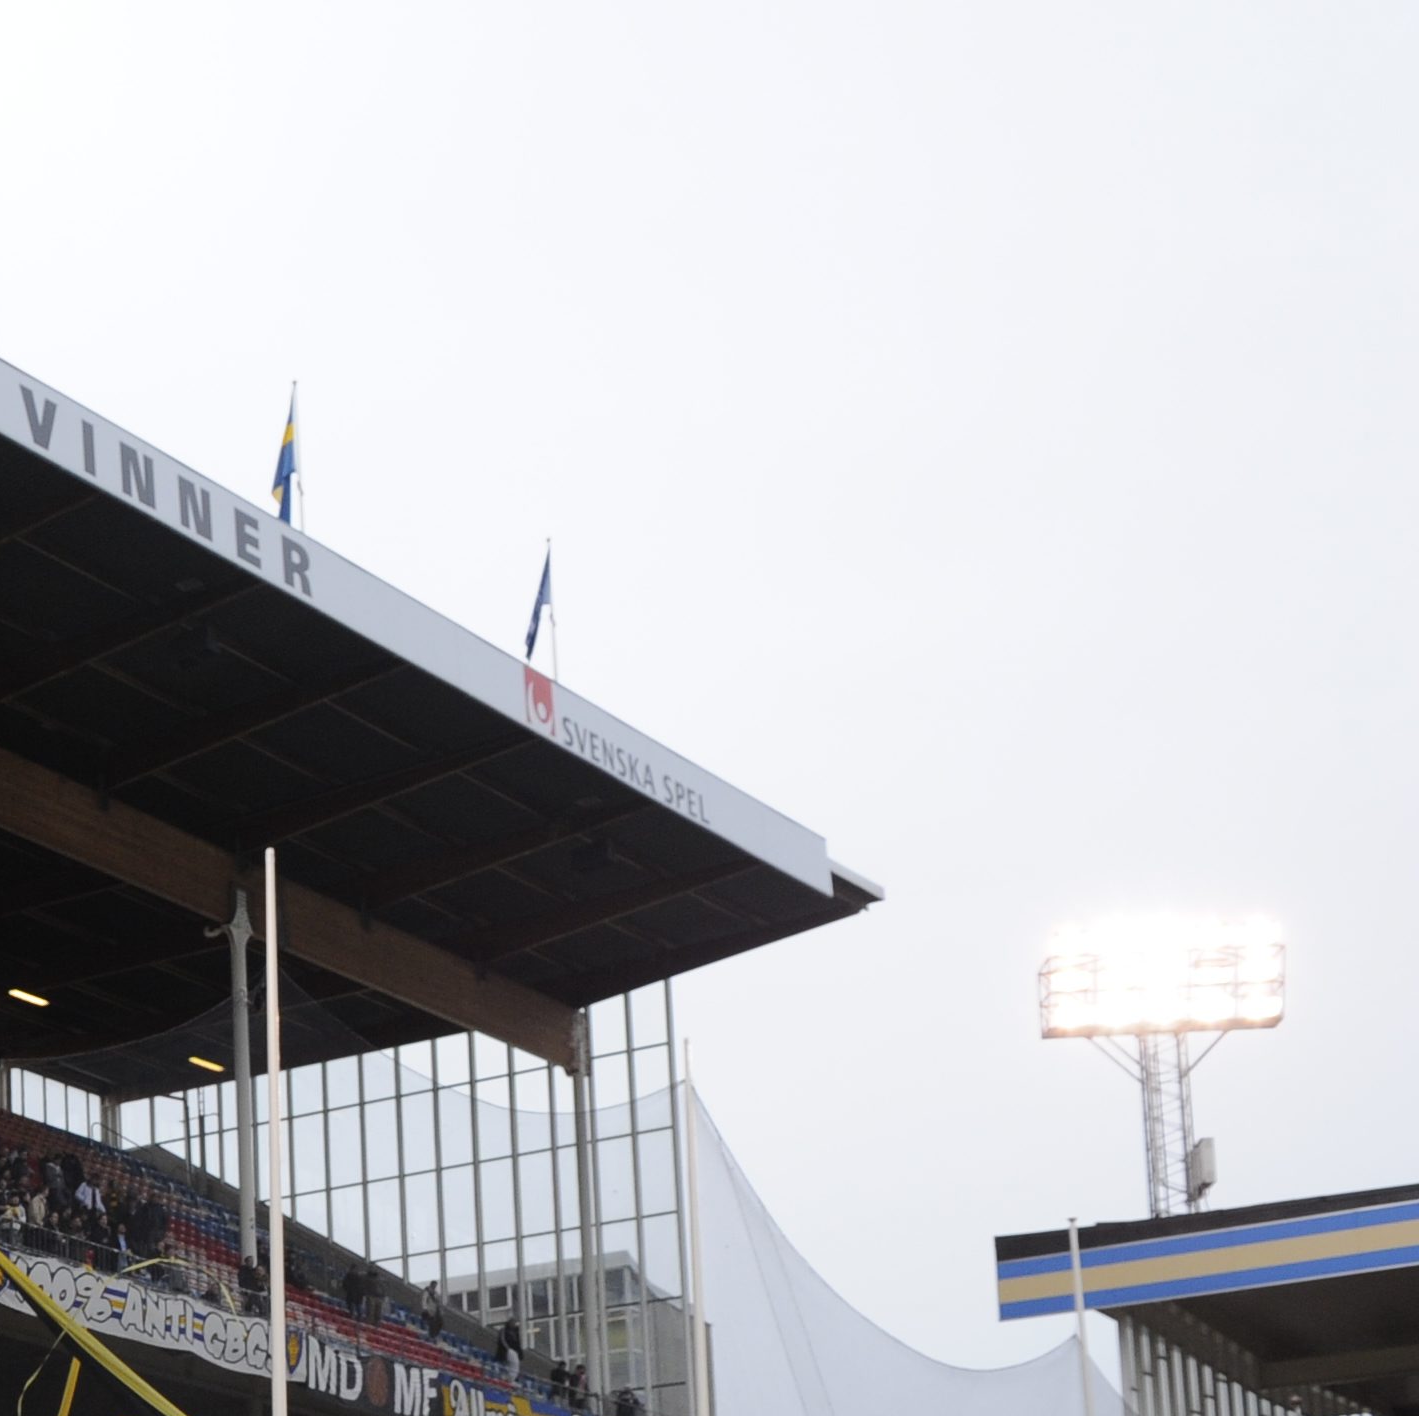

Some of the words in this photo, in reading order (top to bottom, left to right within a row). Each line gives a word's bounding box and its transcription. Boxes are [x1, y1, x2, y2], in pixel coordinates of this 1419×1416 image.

[19, 385, 313, 598] VINNER
[562, 717, 656, 796] SVENSKA
[662, 775, 711, 825] SPEL
[121, 1284, 195, 1344] ANTI
[308, 1335, 363, 1400] MD
